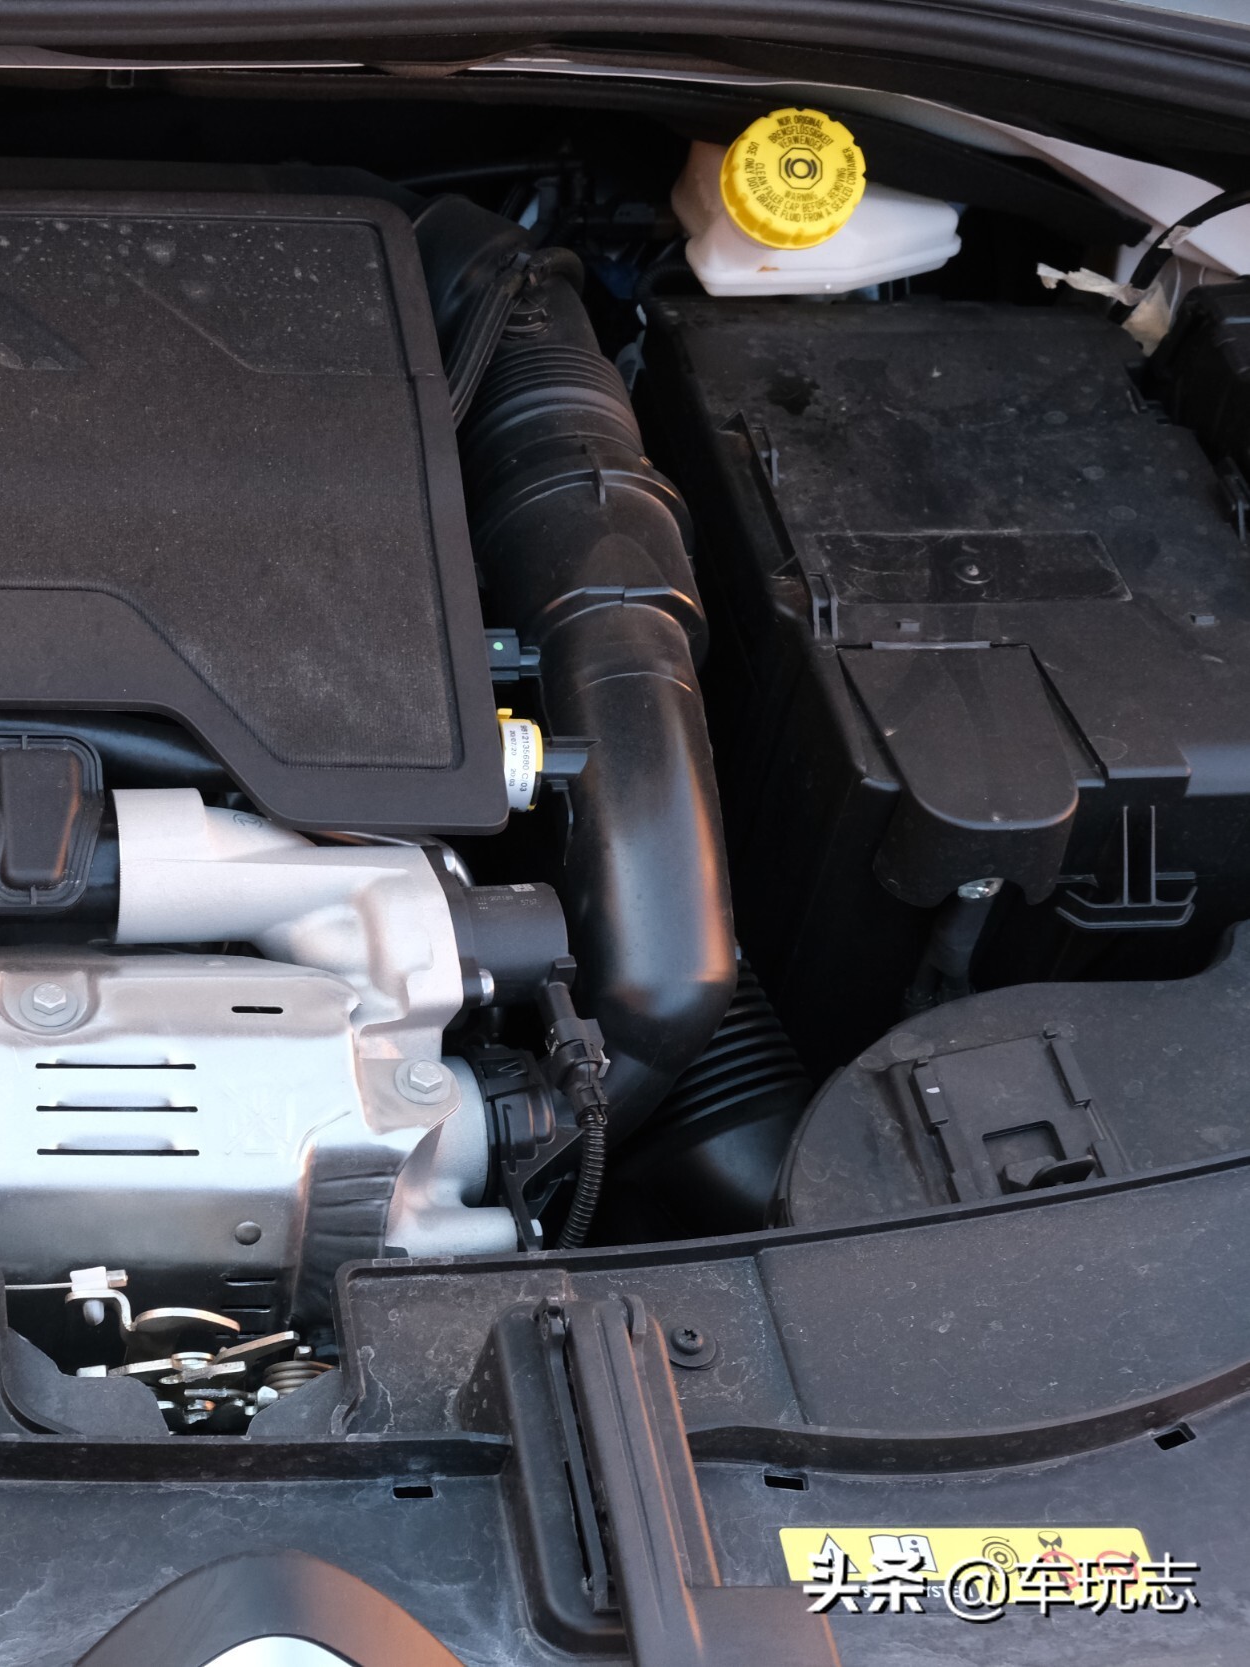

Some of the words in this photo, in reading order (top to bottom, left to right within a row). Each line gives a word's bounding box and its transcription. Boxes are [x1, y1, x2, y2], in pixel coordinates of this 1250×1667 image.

[777, 116, 792, 127] NUR
[793, 115, 824, 129] ORIGINAL
[746, 141, 759, 156] USE
[778, 135, 824, 152] VERWENDEN
[745, 157, 755, 174] ONLY
[842, 146, 857, 186] CONTAINER
[756, 162, 768, 186] CLEAN
[763, 186, 784, 205] FILLER
[784, 200, 800, 212] CAP
[802, 199, 830, 213] BEFORE
[827, 167, 847, 198] REMOVING
[756, 193, 778, 216] BRAKE
[831, 186, 854, 212] SEALED
[780, 209, 801, 222] FLUID
[803, 210, 824, 222] FROM
[826, 208, 833, 217] A
